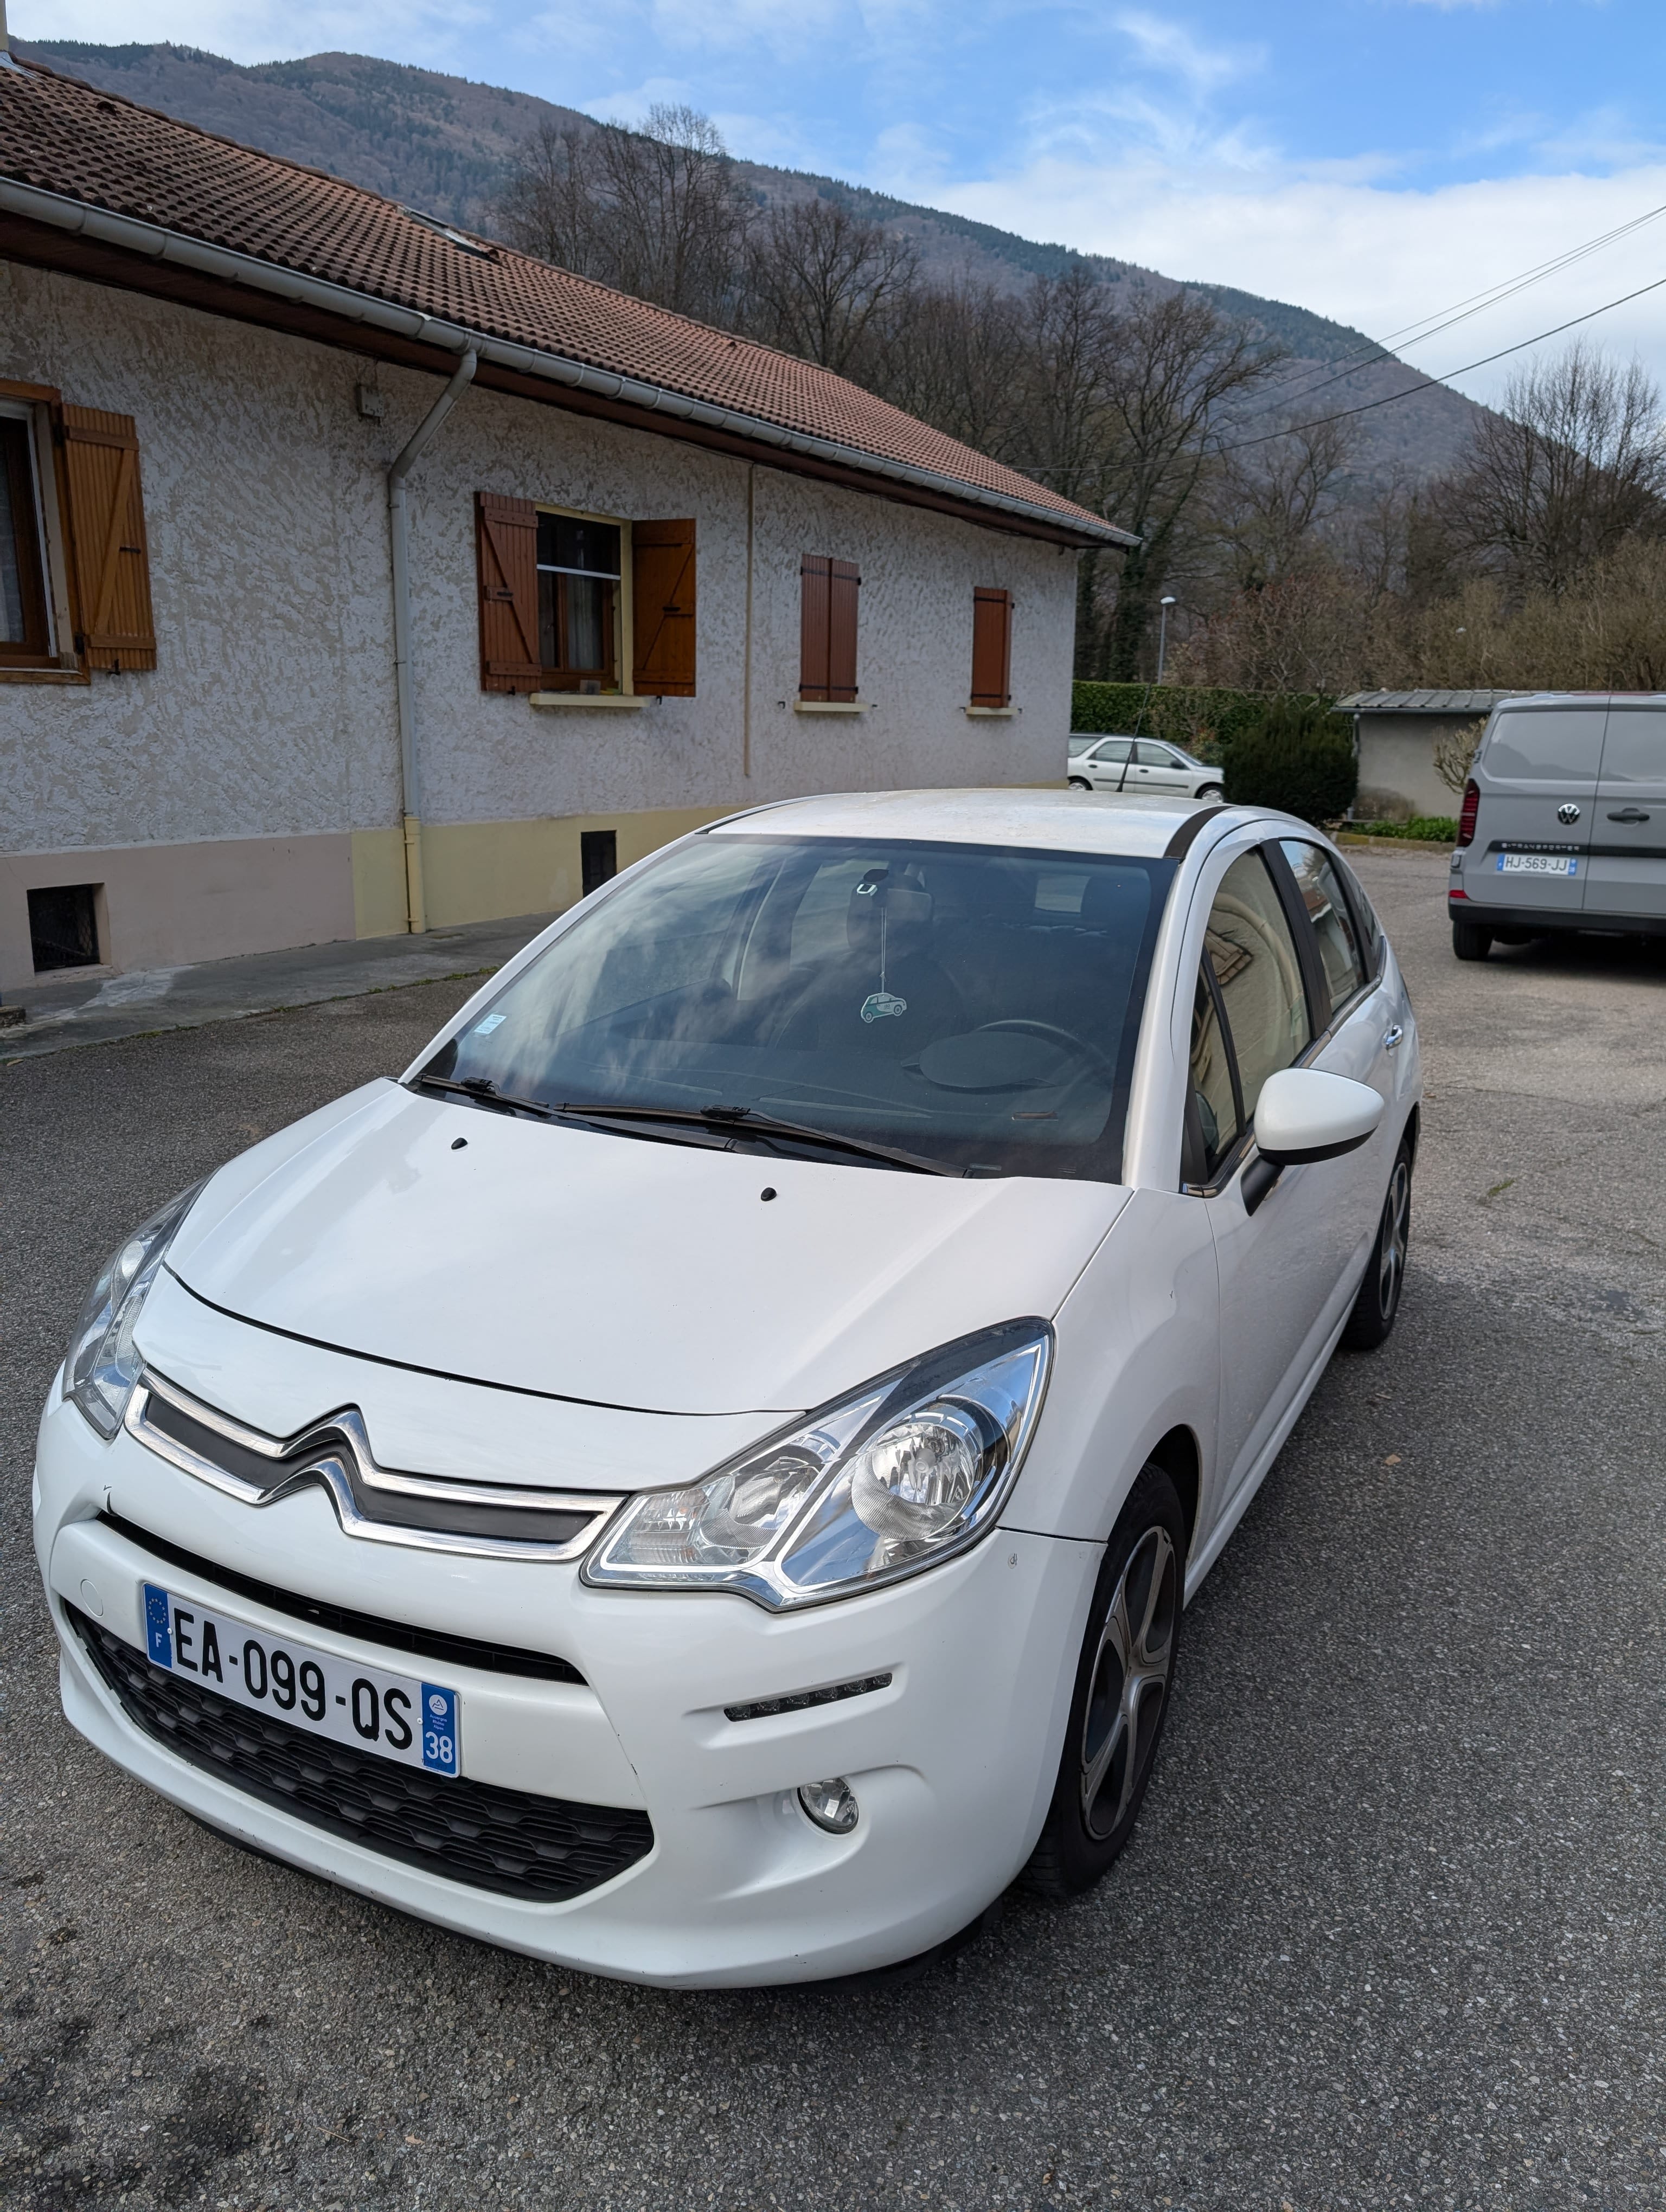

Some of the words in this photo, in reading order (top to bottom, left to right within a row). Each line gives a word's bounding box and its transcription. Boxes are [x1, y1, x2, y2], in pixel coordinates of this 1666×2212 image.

[1505, 856, 1567, 871] HJ-569-JJ
[155, 1632, 163, 1648] F
[174, 1607, 413, 1750] EA-099-QS
[425, 1731, 453, 1764] 38
